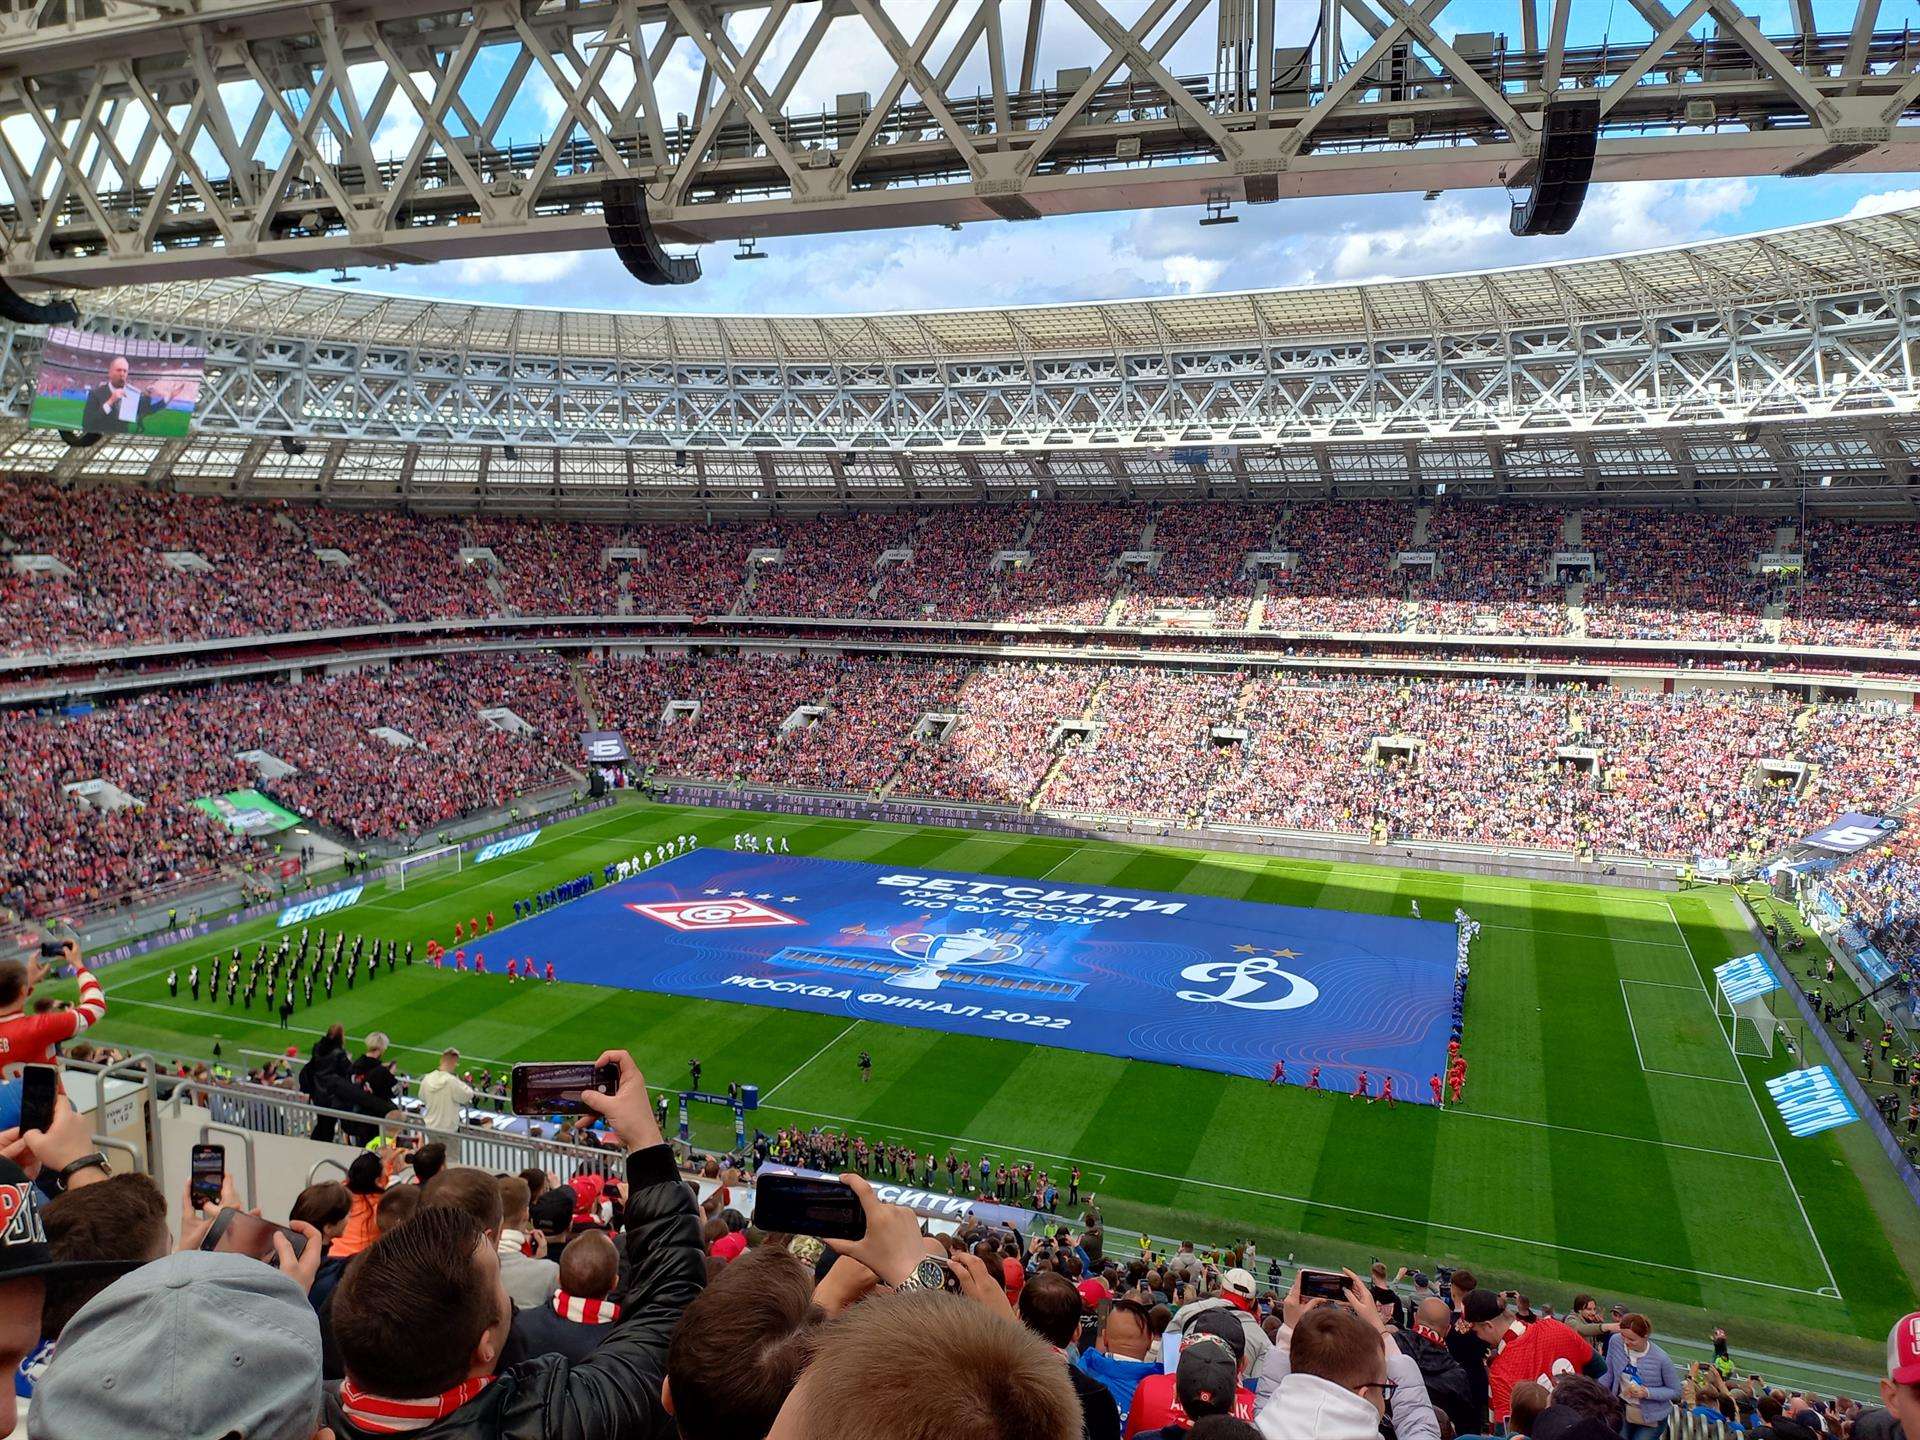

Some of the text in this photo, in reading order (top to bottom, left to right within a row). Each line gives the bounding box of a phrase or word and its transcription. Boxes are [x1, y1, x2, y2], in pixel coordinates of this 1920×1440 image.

[281, 886, 365, 926] БЕТСИТИ
[876, 874, 1188, 915] БЕТСИТИ
[899, 888, 1131, 919] КУБОК РОССИИ
[902, 899, 1104, 925] ПО ФУТБОЛУ
[720, 975, 1072, 1029] МОСКВА ФИНАЛ 2022
